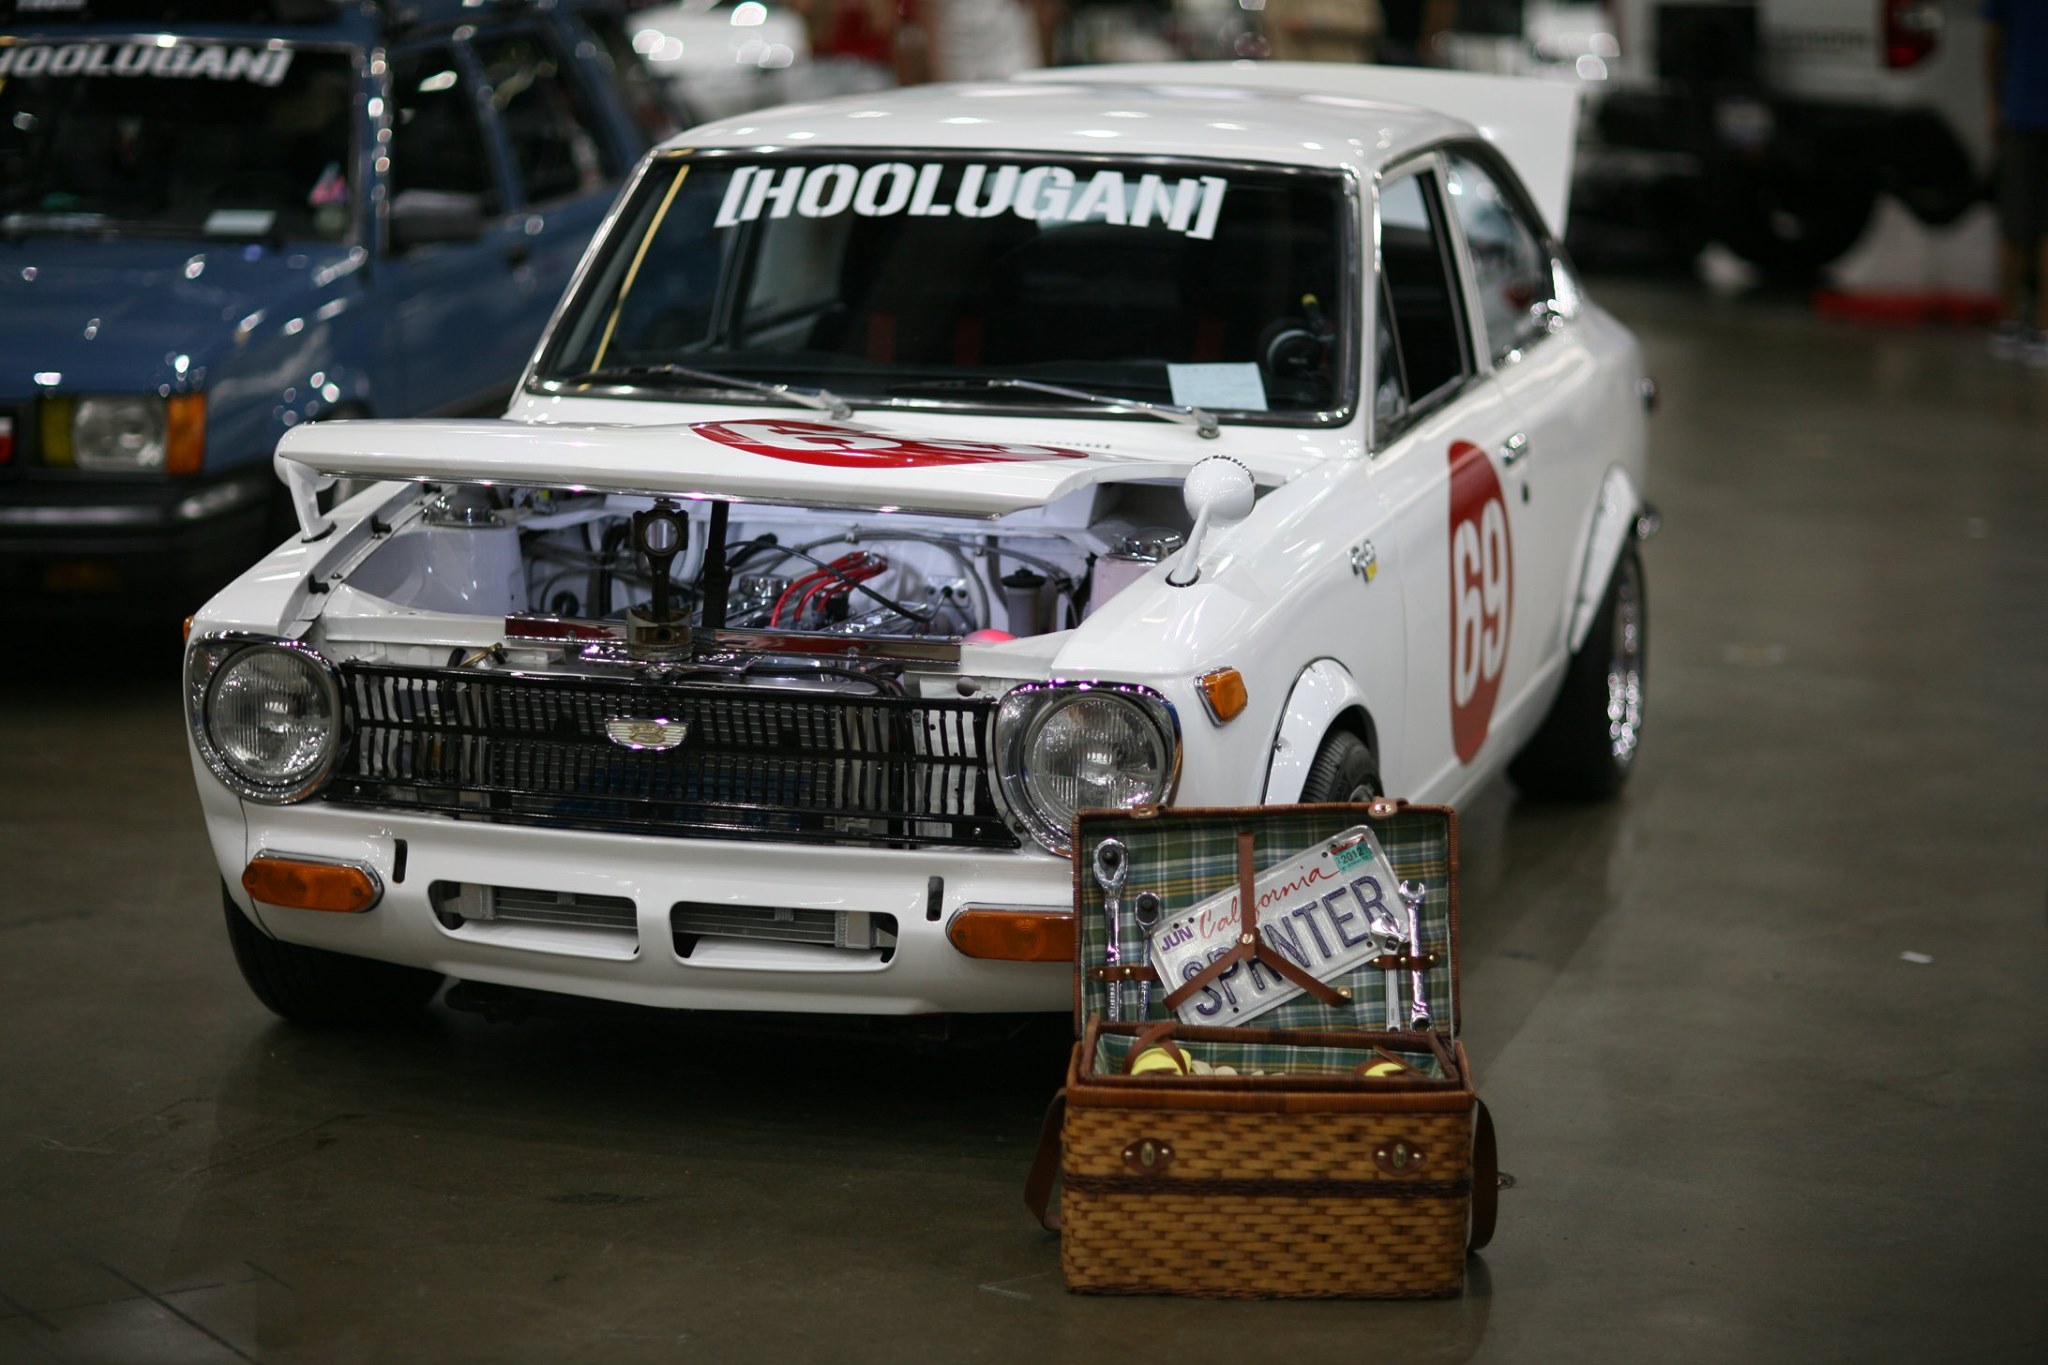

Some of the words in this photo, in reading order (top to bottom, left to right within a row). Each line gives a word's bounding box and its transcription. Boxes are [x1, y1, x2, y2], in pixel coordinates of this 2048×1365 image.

[714, 163, 1227, 240] [HOOLUGAN]
[1453, 498, 1509, 707] 69
[1340, 847, 1364, 864] 2012
[1162, 926, 1193, 951] JUN
[1200, 867, 1340, 939] Calornia
